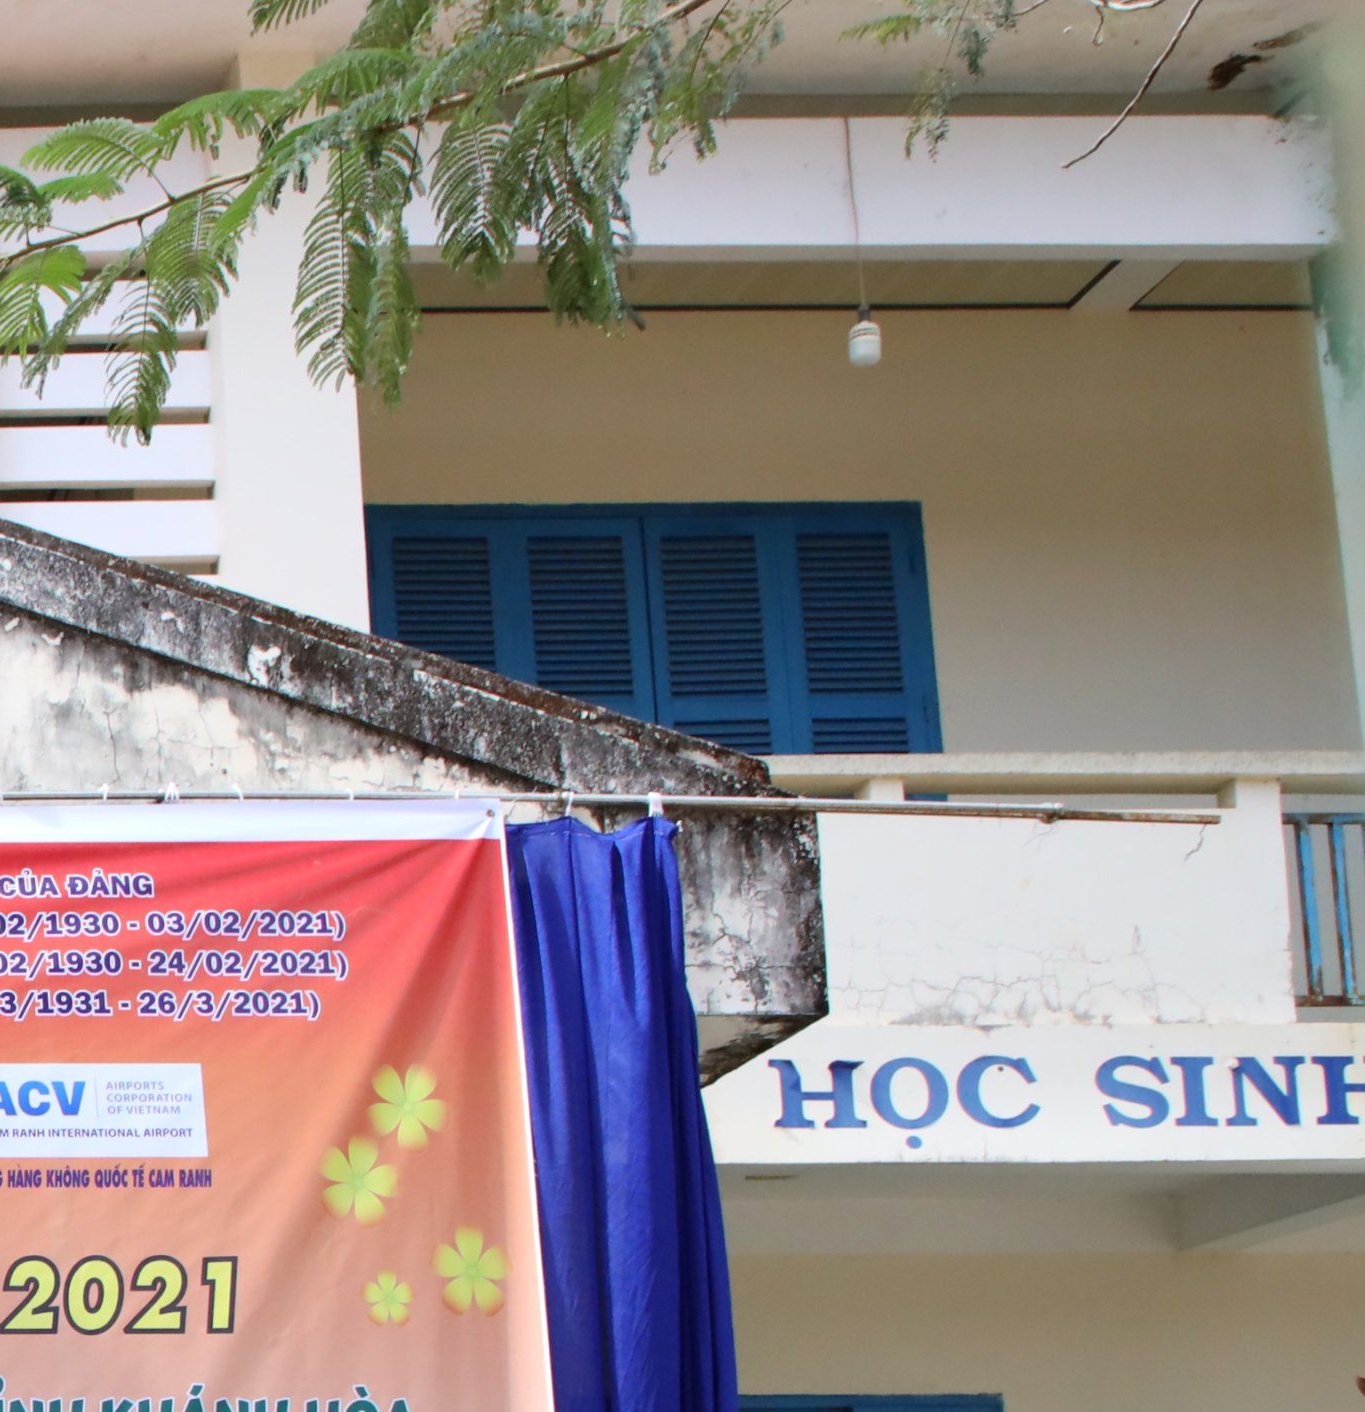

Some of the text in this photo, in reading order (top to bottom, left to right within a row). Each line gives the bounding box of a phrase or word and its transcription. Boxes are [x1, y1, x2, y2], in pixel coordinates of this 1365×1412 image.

[67, 869, 154, 898] ĐẢNG
[127, 918, 141, 932] -
[146, 909, 347, 942] 03/02/2021)
[128, 957, 142, 971] -
[147, 949, 349, 981] 24/02/2021)
[119, 997, 131, 1011] -
[137, 989, 322, 1021] 26/3/2021)
[106, 1081, 165, 1090] AIRPORTS
[106, 1093, 192, 1103] CORPORATION
[108, 1105, 181, 1114] OF VIETNAM
[767, 1054, 1365, 1150] HỌC SINH
[13, 1129, 45, 1137] RANH
[48, 1128, 140, 1137] INTERNATIONAL
[143, 1128, 193, 1137] AIRPORT
[7, 1164, 42, 1188] HÀNG
[46, 1165, 90, 1187] KHÔNG
[94, 1163, 128, 1189] QUỐC
[132, 1162, 145, 1187] TẾ
[148, 1169, 174, 1187] CAM
[179, 1169, 212, 1187] RANH
